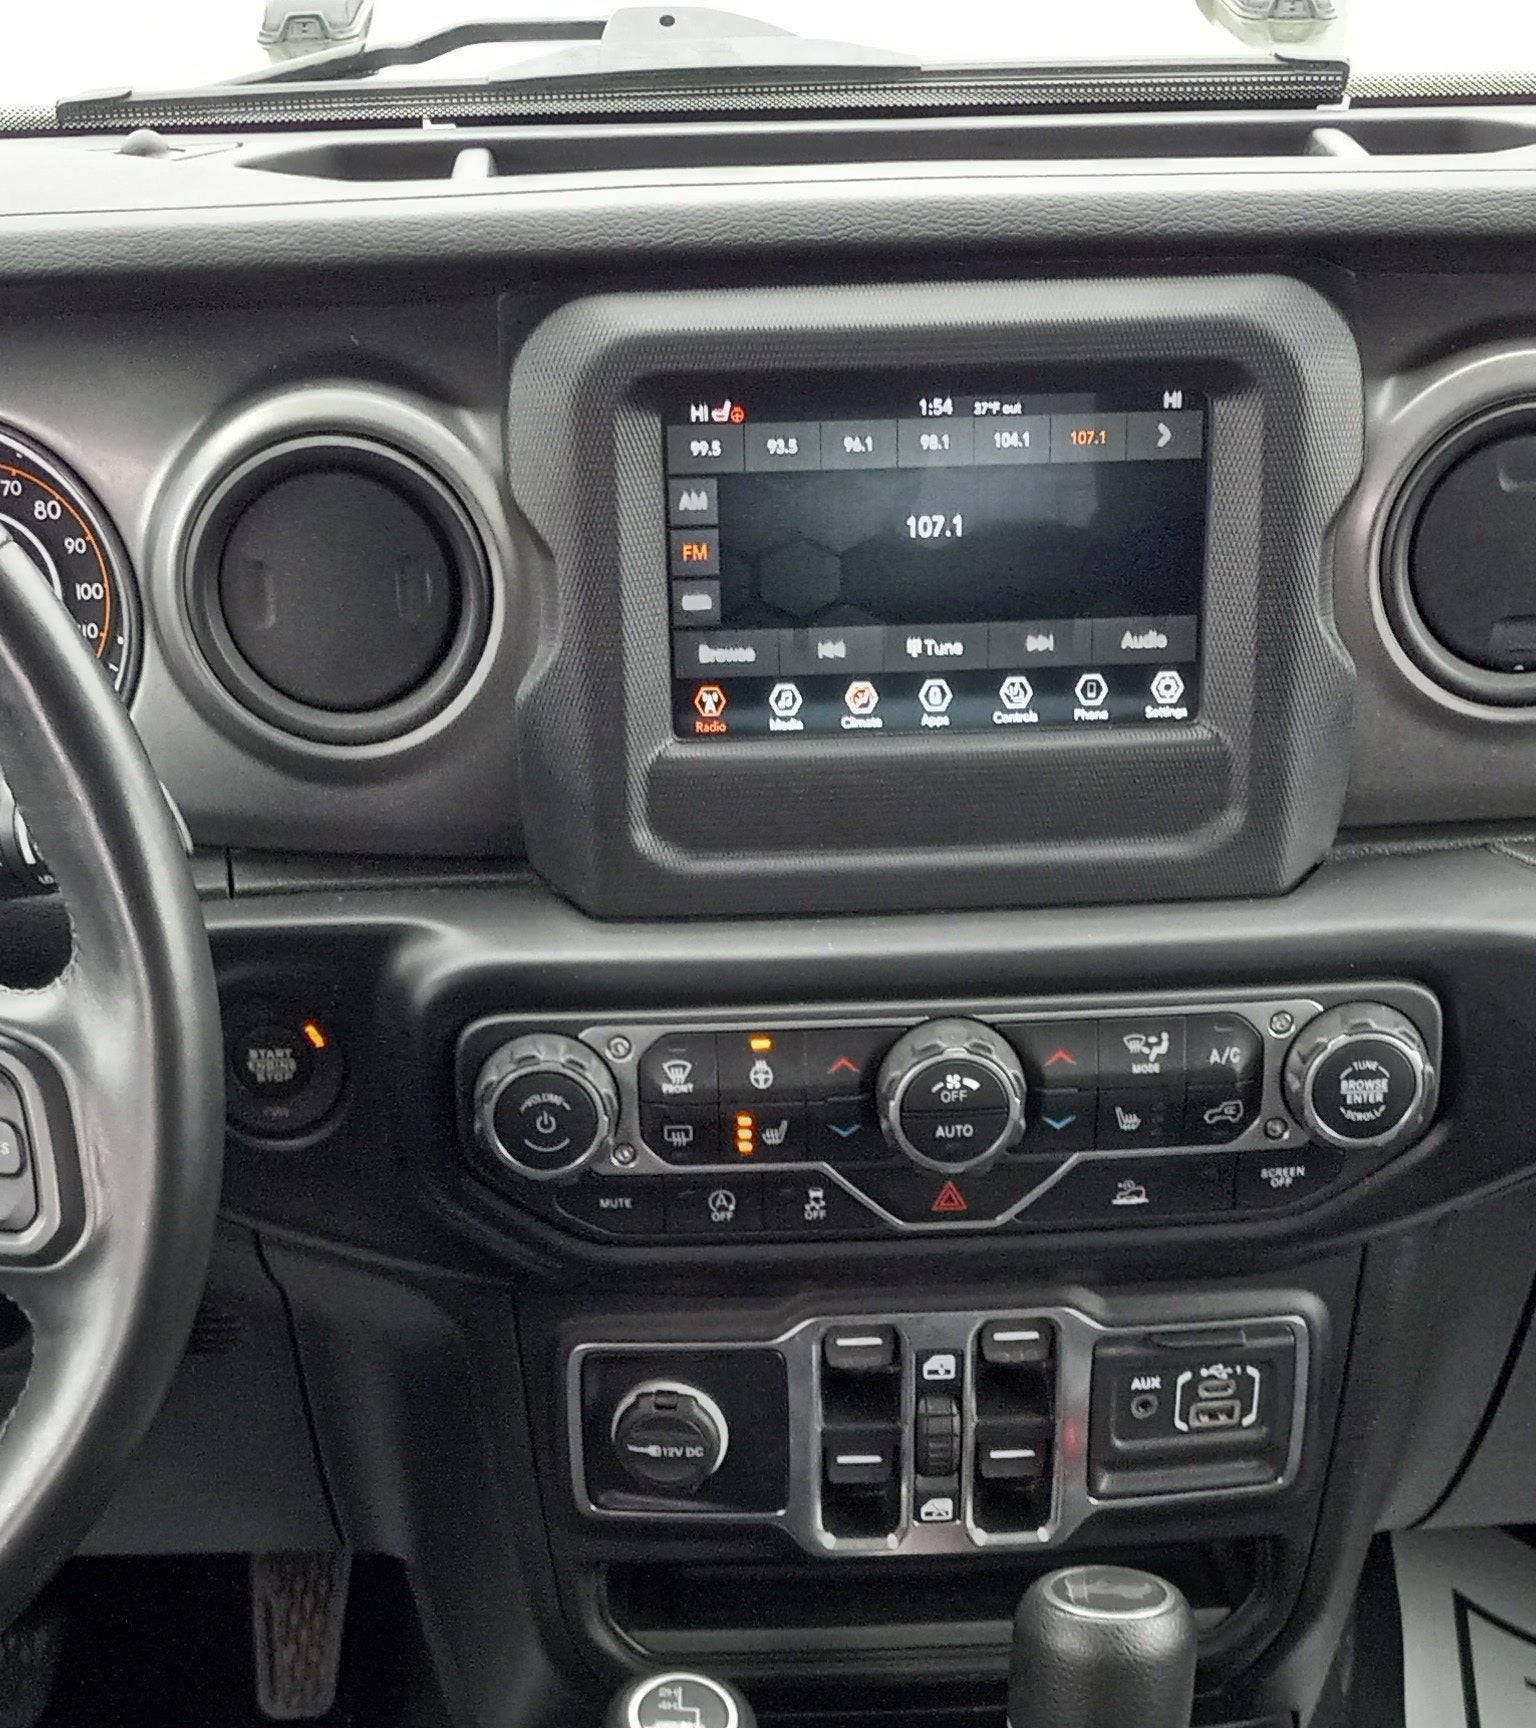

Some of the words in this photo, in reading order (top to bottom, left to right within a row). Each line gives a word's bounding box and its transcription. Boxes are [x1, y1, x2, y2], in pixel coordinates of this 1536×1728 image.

[919, 397, 953, 416] 1:54
[1163, 390, 1182, 409] HI
[690, 402, 709, 423] HI
[690, 440, 721, 457] 99.5
[767, 438, 799, 455] 93.5
[994, 431, 1030, 448] 104.1
[1070, 430, 1106, 445] 107.1
[0, 480, 22, 497] 70
[679, 489, 708, 511] AM
[33, 500, 62, 521] 80
[906, 514, 963, 540] 107.1
[64, 538, 87, 555] 90
[683, 543, 708, 561] FM
[75, 583, 104, 600] 100
[78, 623, 99, 640] 10
[695, 720, 727, 733] Radio
[1209, 1045, 1241, 1065] A/C
[1352, 1059, 1379, 1071] TUNE
[1340, 1078, 1388, 1091] BROWSE
[940, 1089, 968, 1103] OFF
[1346, 1092, 1384, 1105] ENTER
[935, 1124, 974, 1139] AUTO
[600, 1198, 632, 1209] MUTE
[711, 1211, 733, 1222] OFF
[804, 1209, 827, 1221] OFF
[1130, 1375, 1161, 1391] AUX
[662, 1446, 683, 1458] 12V
